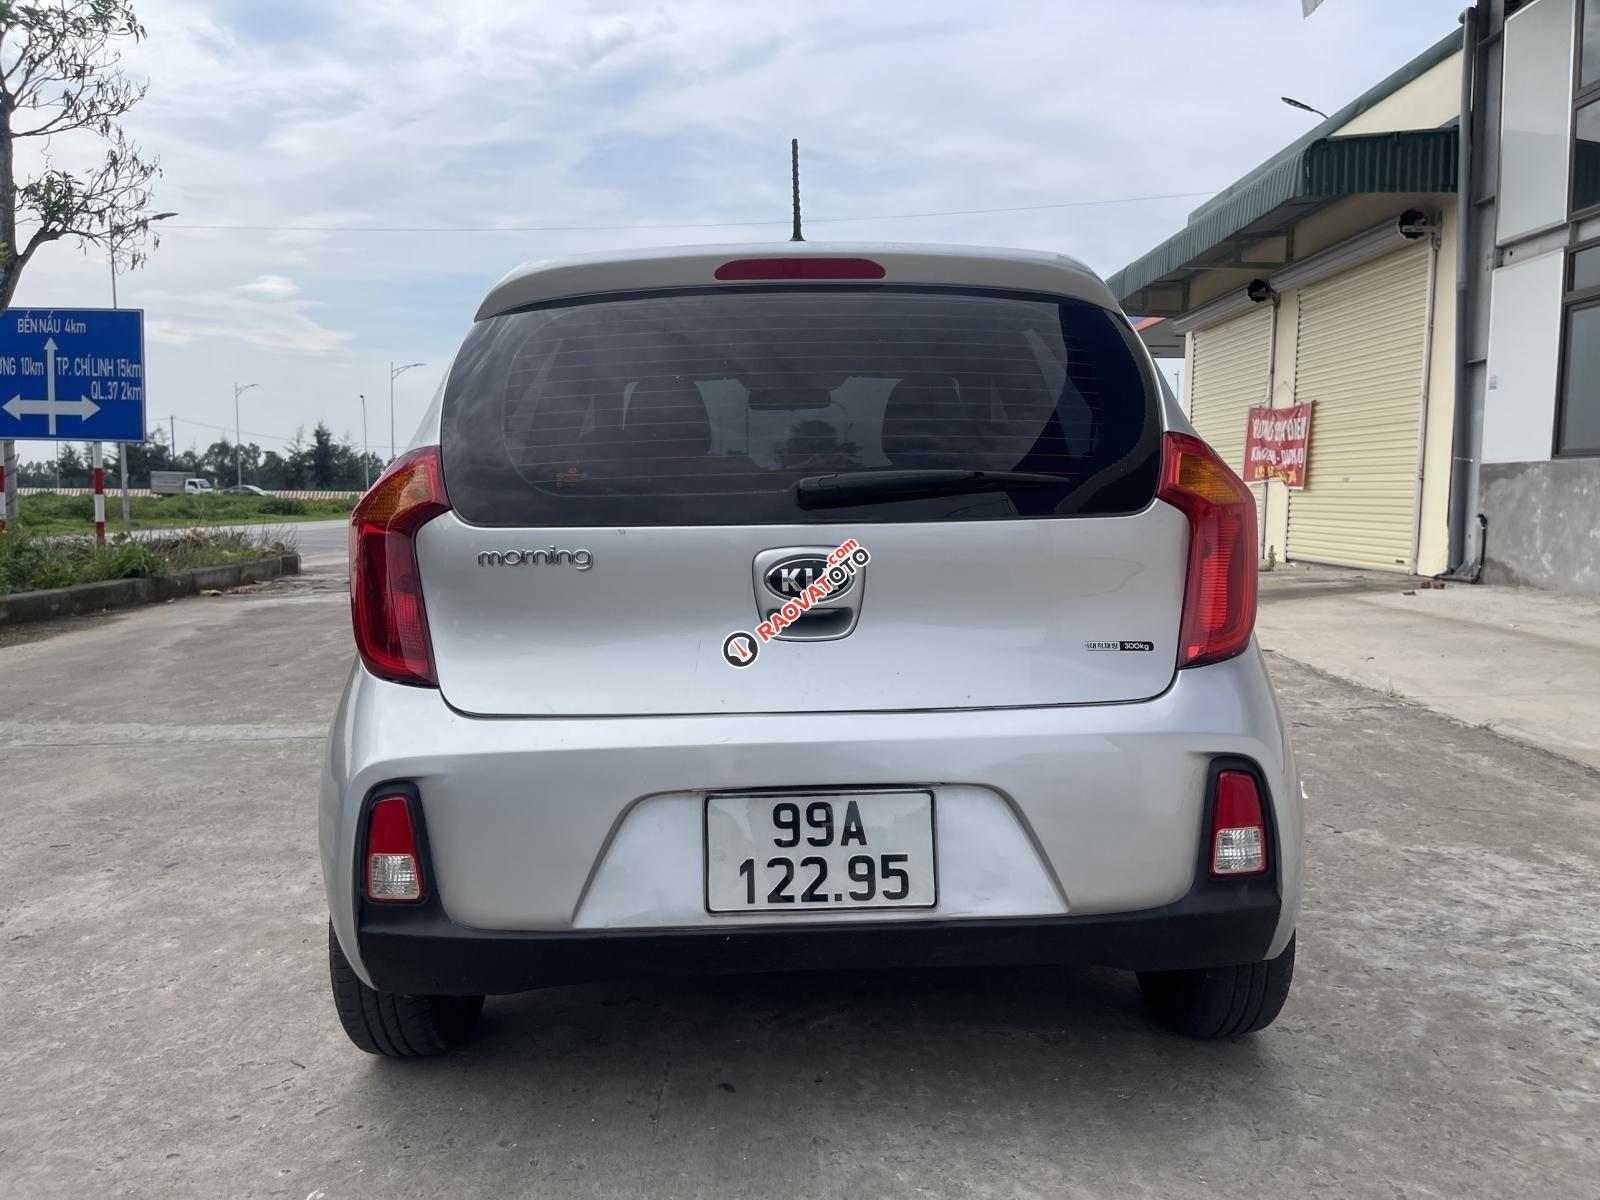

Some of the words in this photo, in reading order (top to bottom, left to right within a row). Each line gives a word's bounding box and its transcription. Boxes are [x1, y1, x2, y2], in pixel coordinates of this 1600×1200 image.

[17, 310, 38, 333] BẾN
[65, 319, 86, 333] 4km
[21, 357, 44, 376] 10km
[56, 357, 72, 376] TP.
[74, 353, 91, 376] CHÍ
[91, 358, 114, 377] LINH
[117, 359, 141, 378] 15km
[91, 381, 118, 400] QL.37
[121, 381, 141, 400] 2km
[478, 545, 593, 571] morning
[781, 567, 839, 592] KI
[1124, 642, 1150, 651] 300kg
[772, 800, 868, 848] 99A
[739, 853, 910, 905] 122.95
